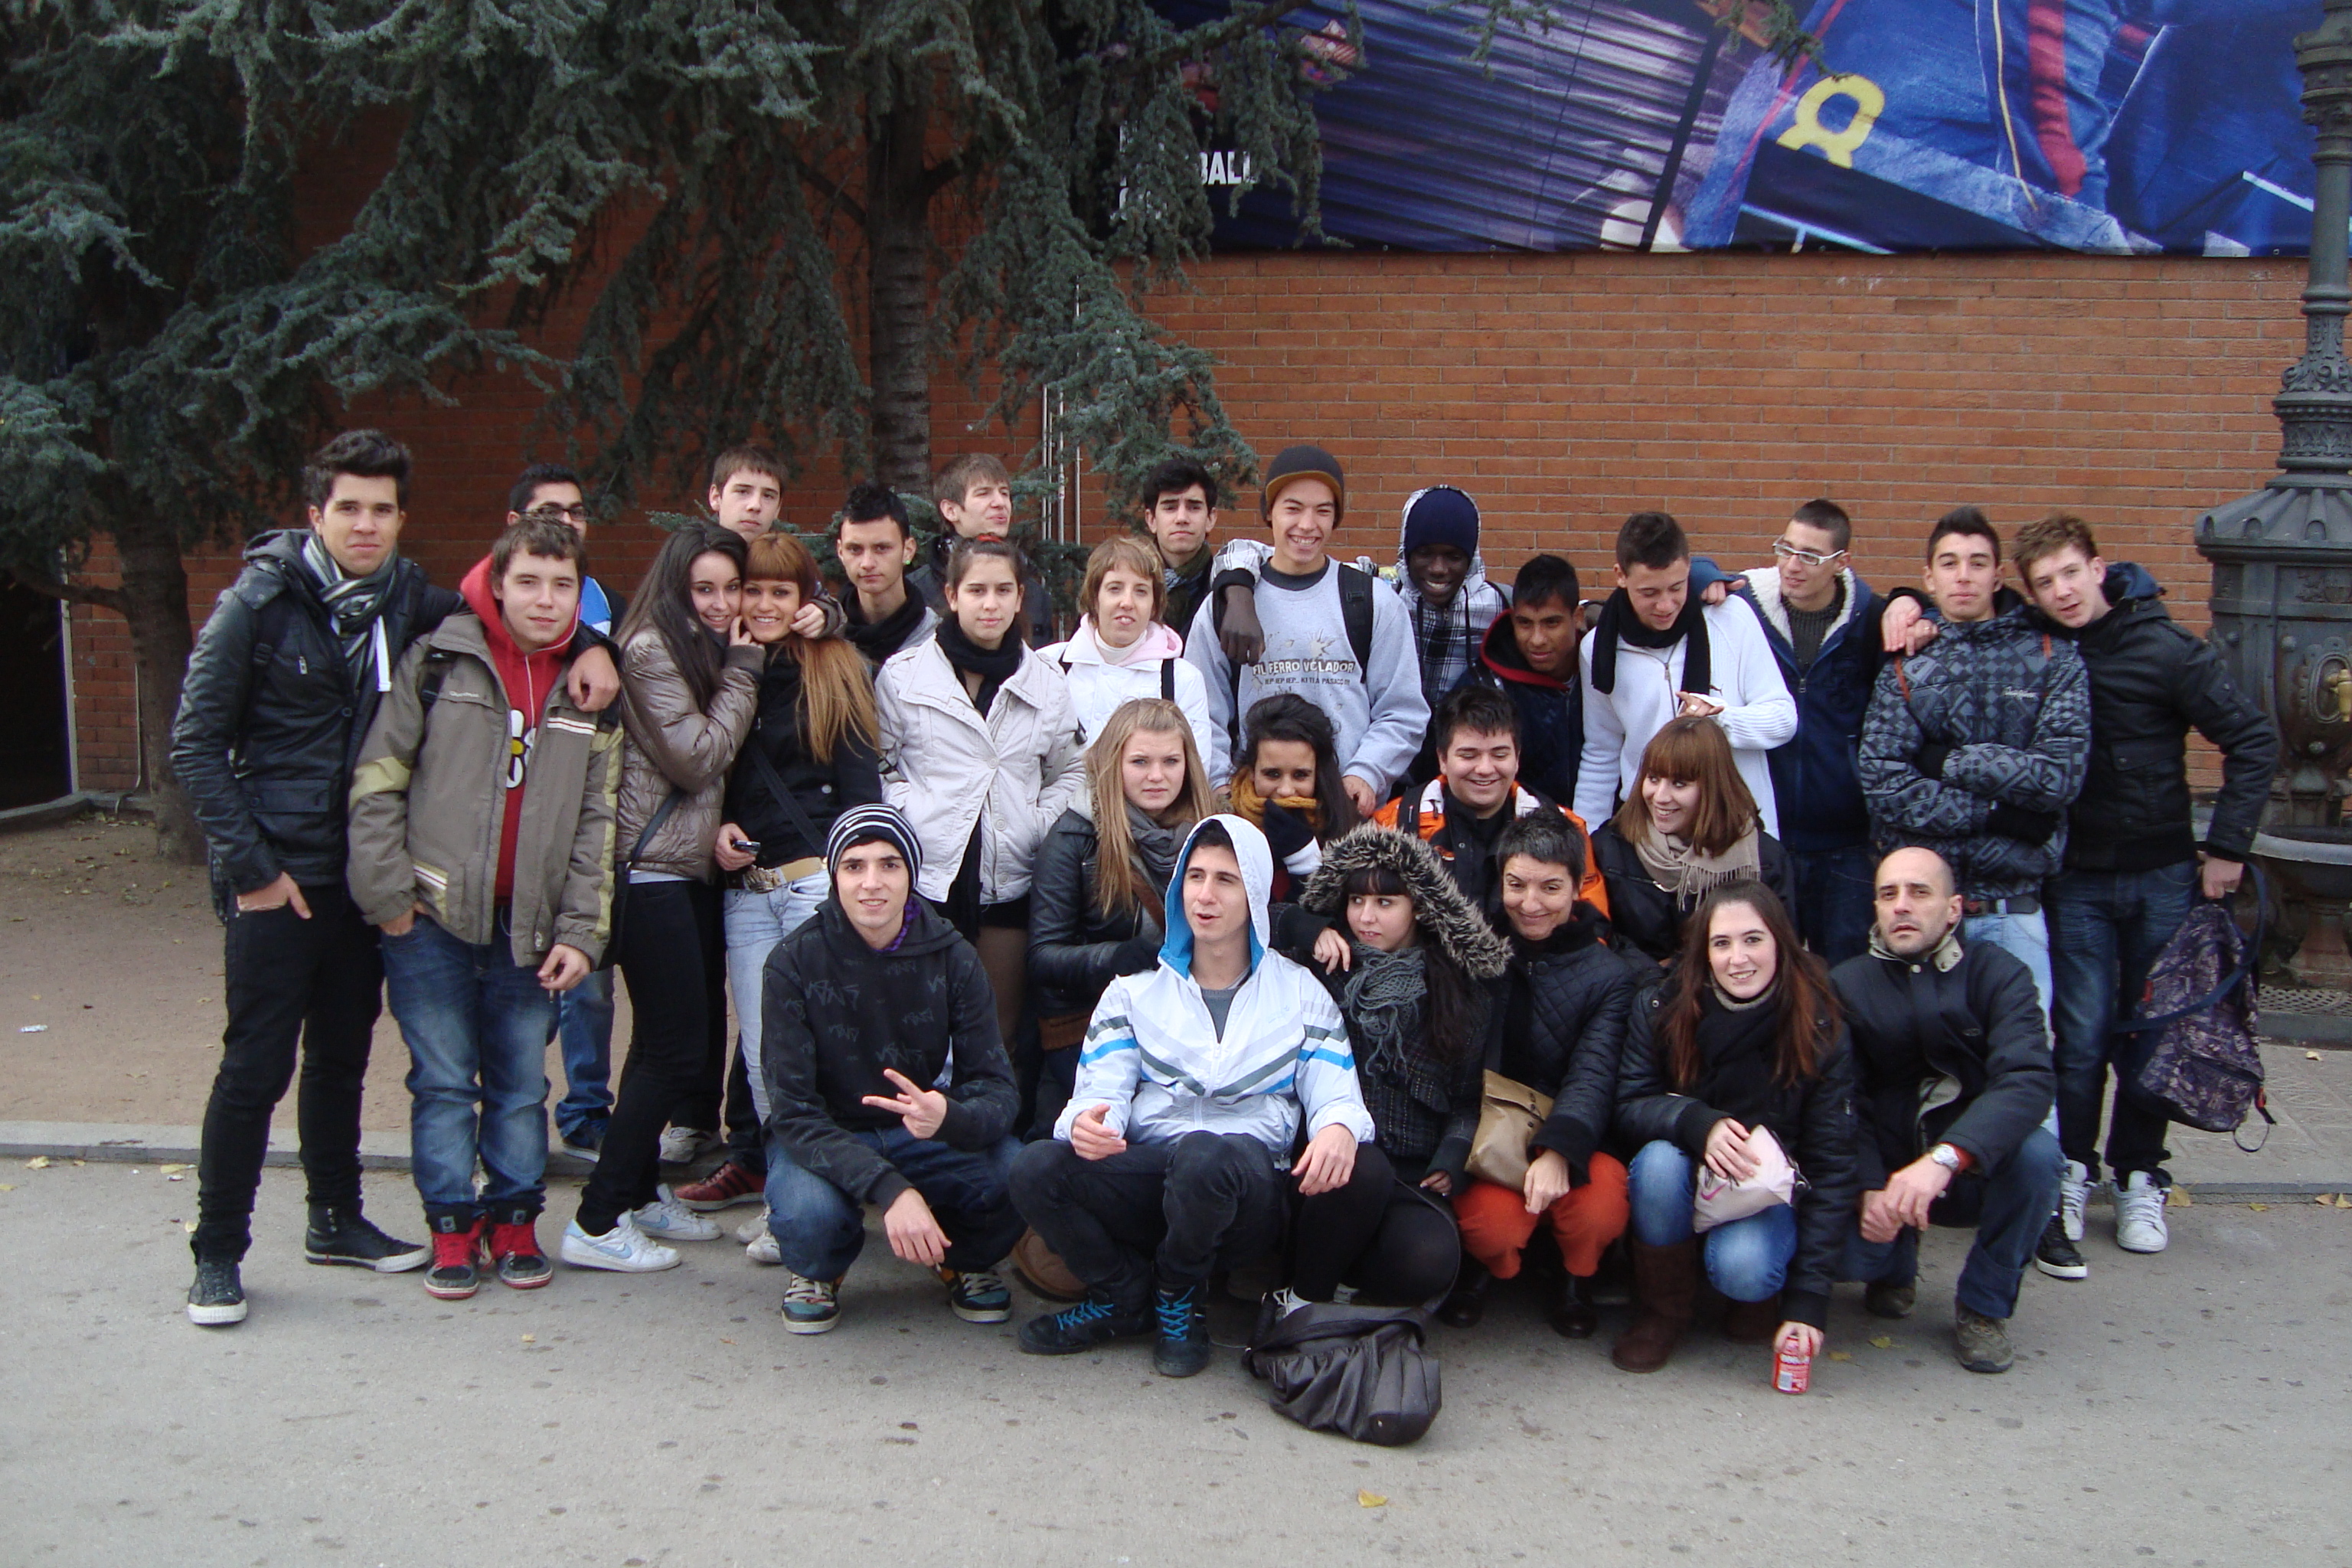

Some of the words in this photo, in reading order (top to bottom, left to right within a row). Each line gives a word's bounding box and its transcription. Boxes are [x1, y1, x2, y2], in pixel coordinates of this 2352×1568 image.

[1253, 662, 1266, 676] FIL
[1269, 660, 1300, 675] FERRO
[1303, 659, 1355, 675] VOLADOR
